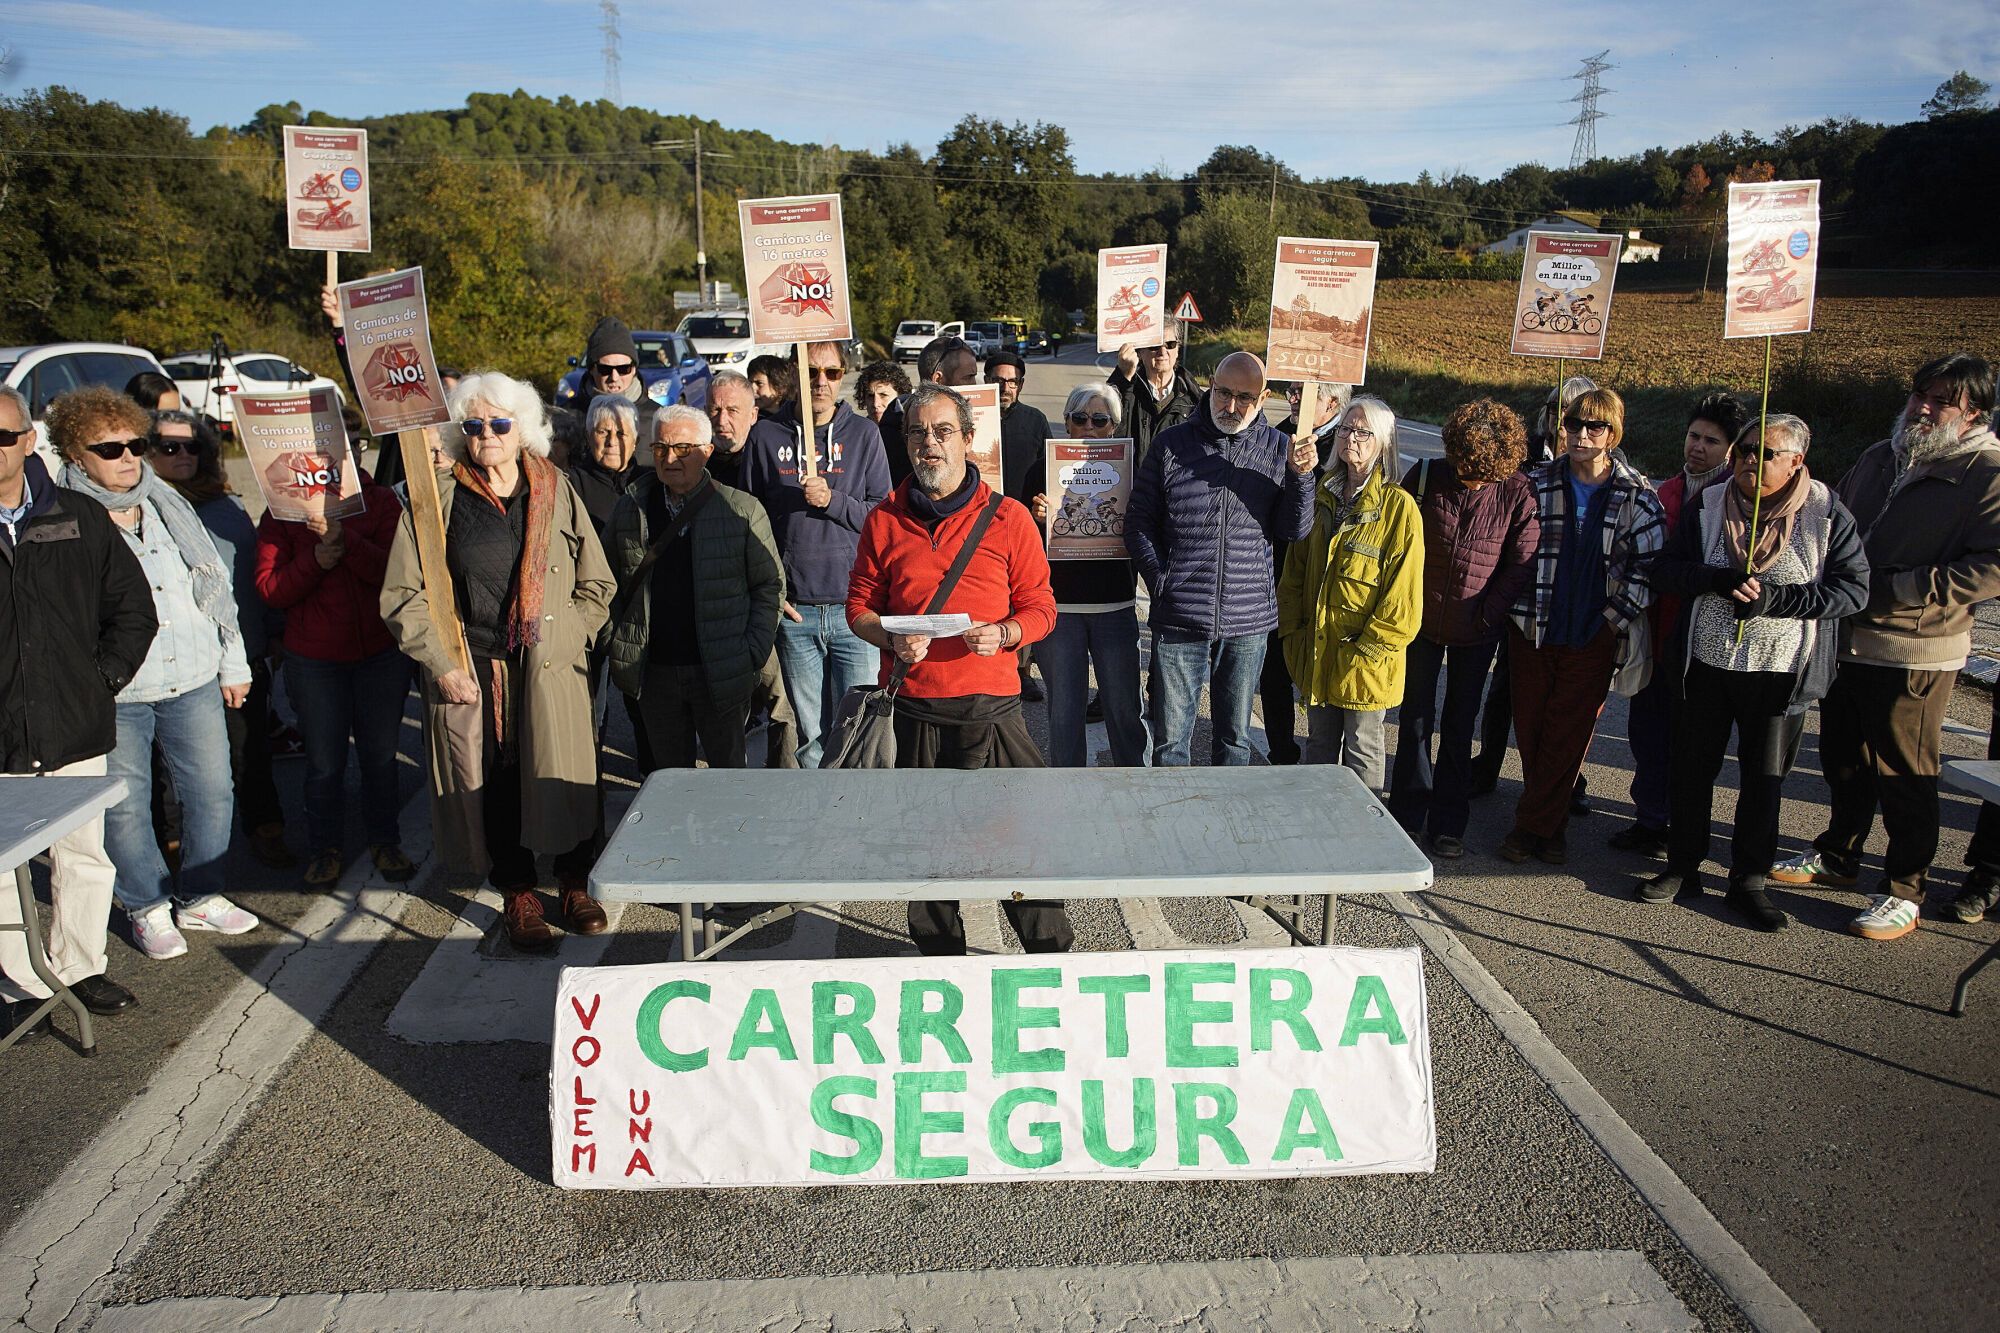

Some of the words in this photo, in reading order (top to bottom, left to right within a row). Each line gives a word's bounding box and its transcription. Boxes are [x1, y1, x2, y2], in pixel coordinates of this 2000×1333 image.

[754, 232, 811, 247] Camions
[815, 230, 832, 243] de
[762, 249, 778, 261] 16
[782, 248, 828, 260] metres
[1313, 256, 1337, 264] segura
[1323, 249, 1356, 257] carretera
[1551, 261, 1583, 270] Millor
[1552, 272, 1568, 280] fila
[1570, 273, 1592, 281] d'un
[380, 283, 403, 293] carretera
[791, 283, 833, 301] NO!
[374, 293, 391, 302] segura
[353, 313, 400, 331] Camions
[403, 308, 417, 320] de
[360, 333, 374, 346] 16
[376, 326, 415, 343] metres
[1275, 351, 1332, 367] STOP
[388, 363, 425, 386] NO!
[281, 399, 311, 407] carretera
[251, 423, 310, 436] Camions
[314, 421, 332, 433] de
[261, 439, 277, 449] 16
[282, 437, 330, 449] metres
[296, 468, 340, 487] NO!
[1072, 467, 1102, 475] Millor
[635, 961, 1408, 1078] CARRETERA
[571, 993, 601, 1174] VOLEM
[626, 1087, 655, 1177] UNA
[809, 1070, 1344, 1179] SEGURA
